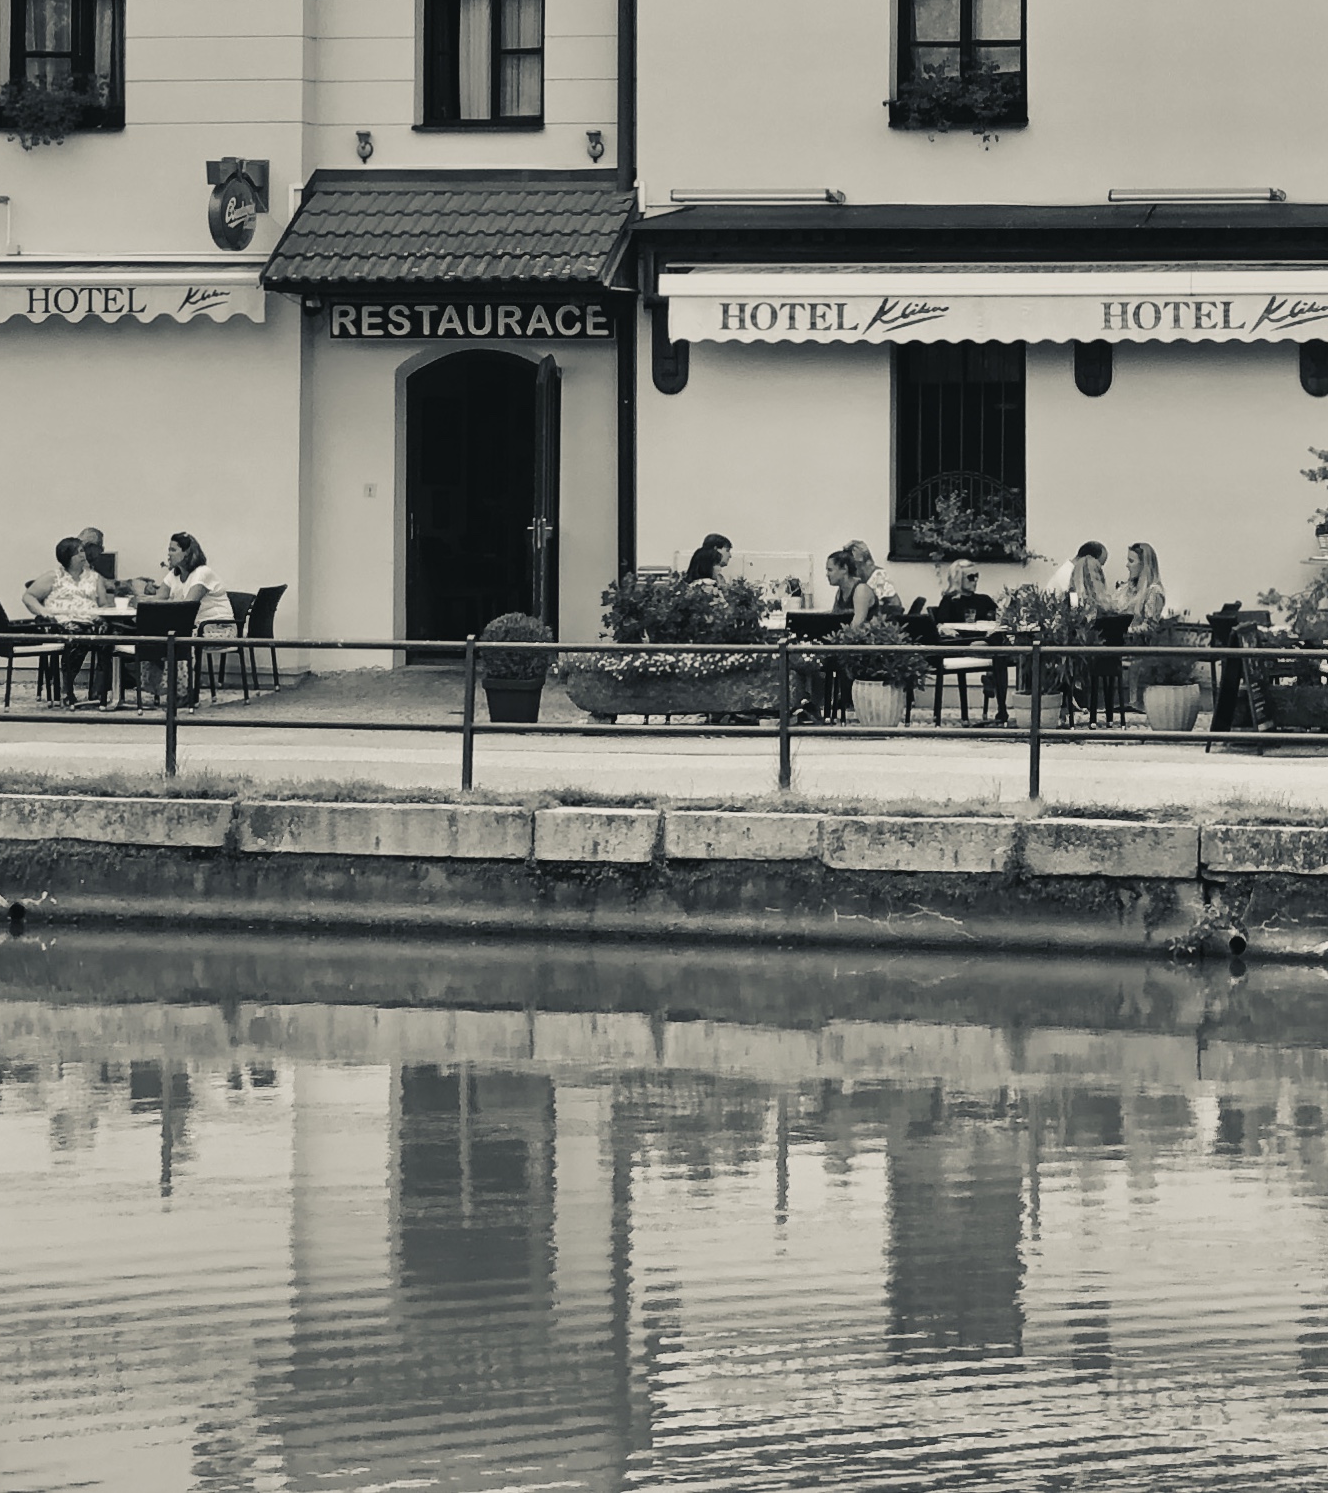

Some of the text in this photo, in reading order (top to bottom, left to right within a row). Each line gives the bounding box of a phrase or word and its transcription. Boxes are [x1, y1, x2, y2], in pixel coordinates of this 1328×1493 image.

[26, 287, 148, 314] HOTEL
[1100, 300, 1247, 330] HOTEL
[332, 304, 610, 336] RESTAURACE
[719, 301, 860, 331] HOTEL
